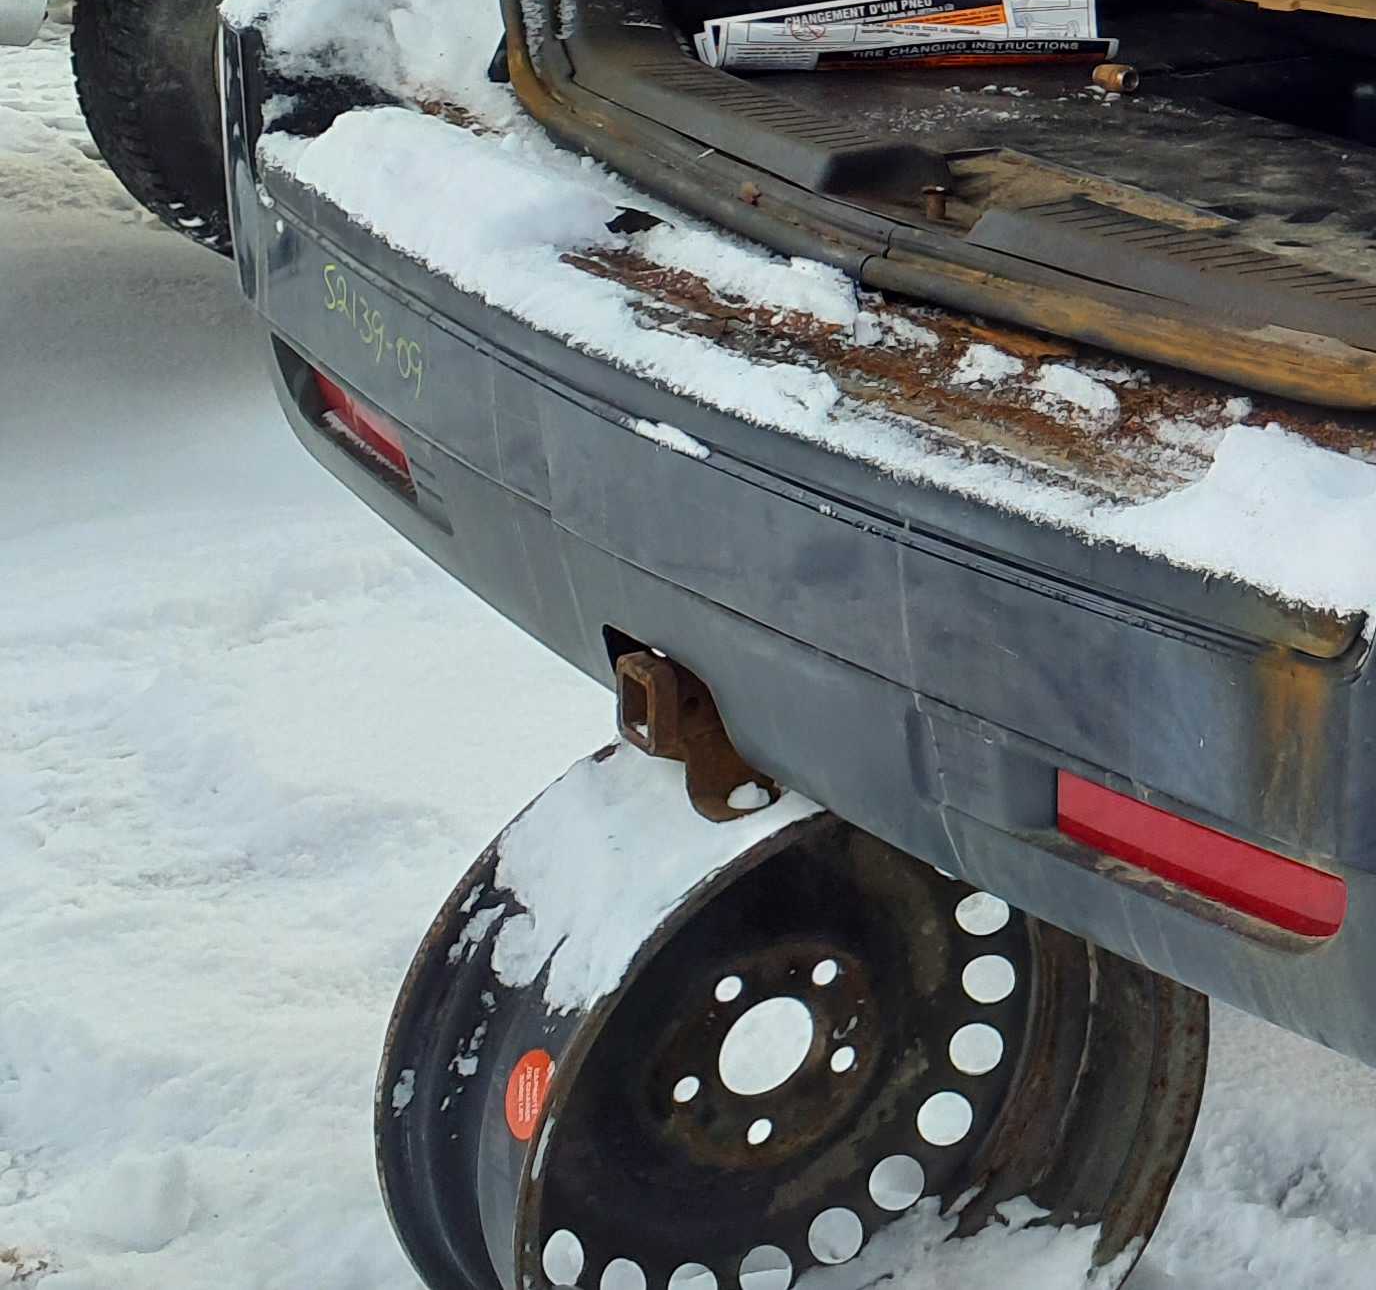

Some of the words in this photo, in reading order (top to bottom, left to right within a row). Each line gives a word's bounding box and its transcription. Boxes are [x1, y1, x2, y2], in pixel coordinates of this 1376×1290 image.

[784, 5, 866, 27] CHANGEMENT
[869, 0, 899, 15] D'UN
[852, 49, 884, 58] TIRE
[888, 42, 967, 57] CHANGING
[971, 41, 1079, 51] INSTRUCTIONS
